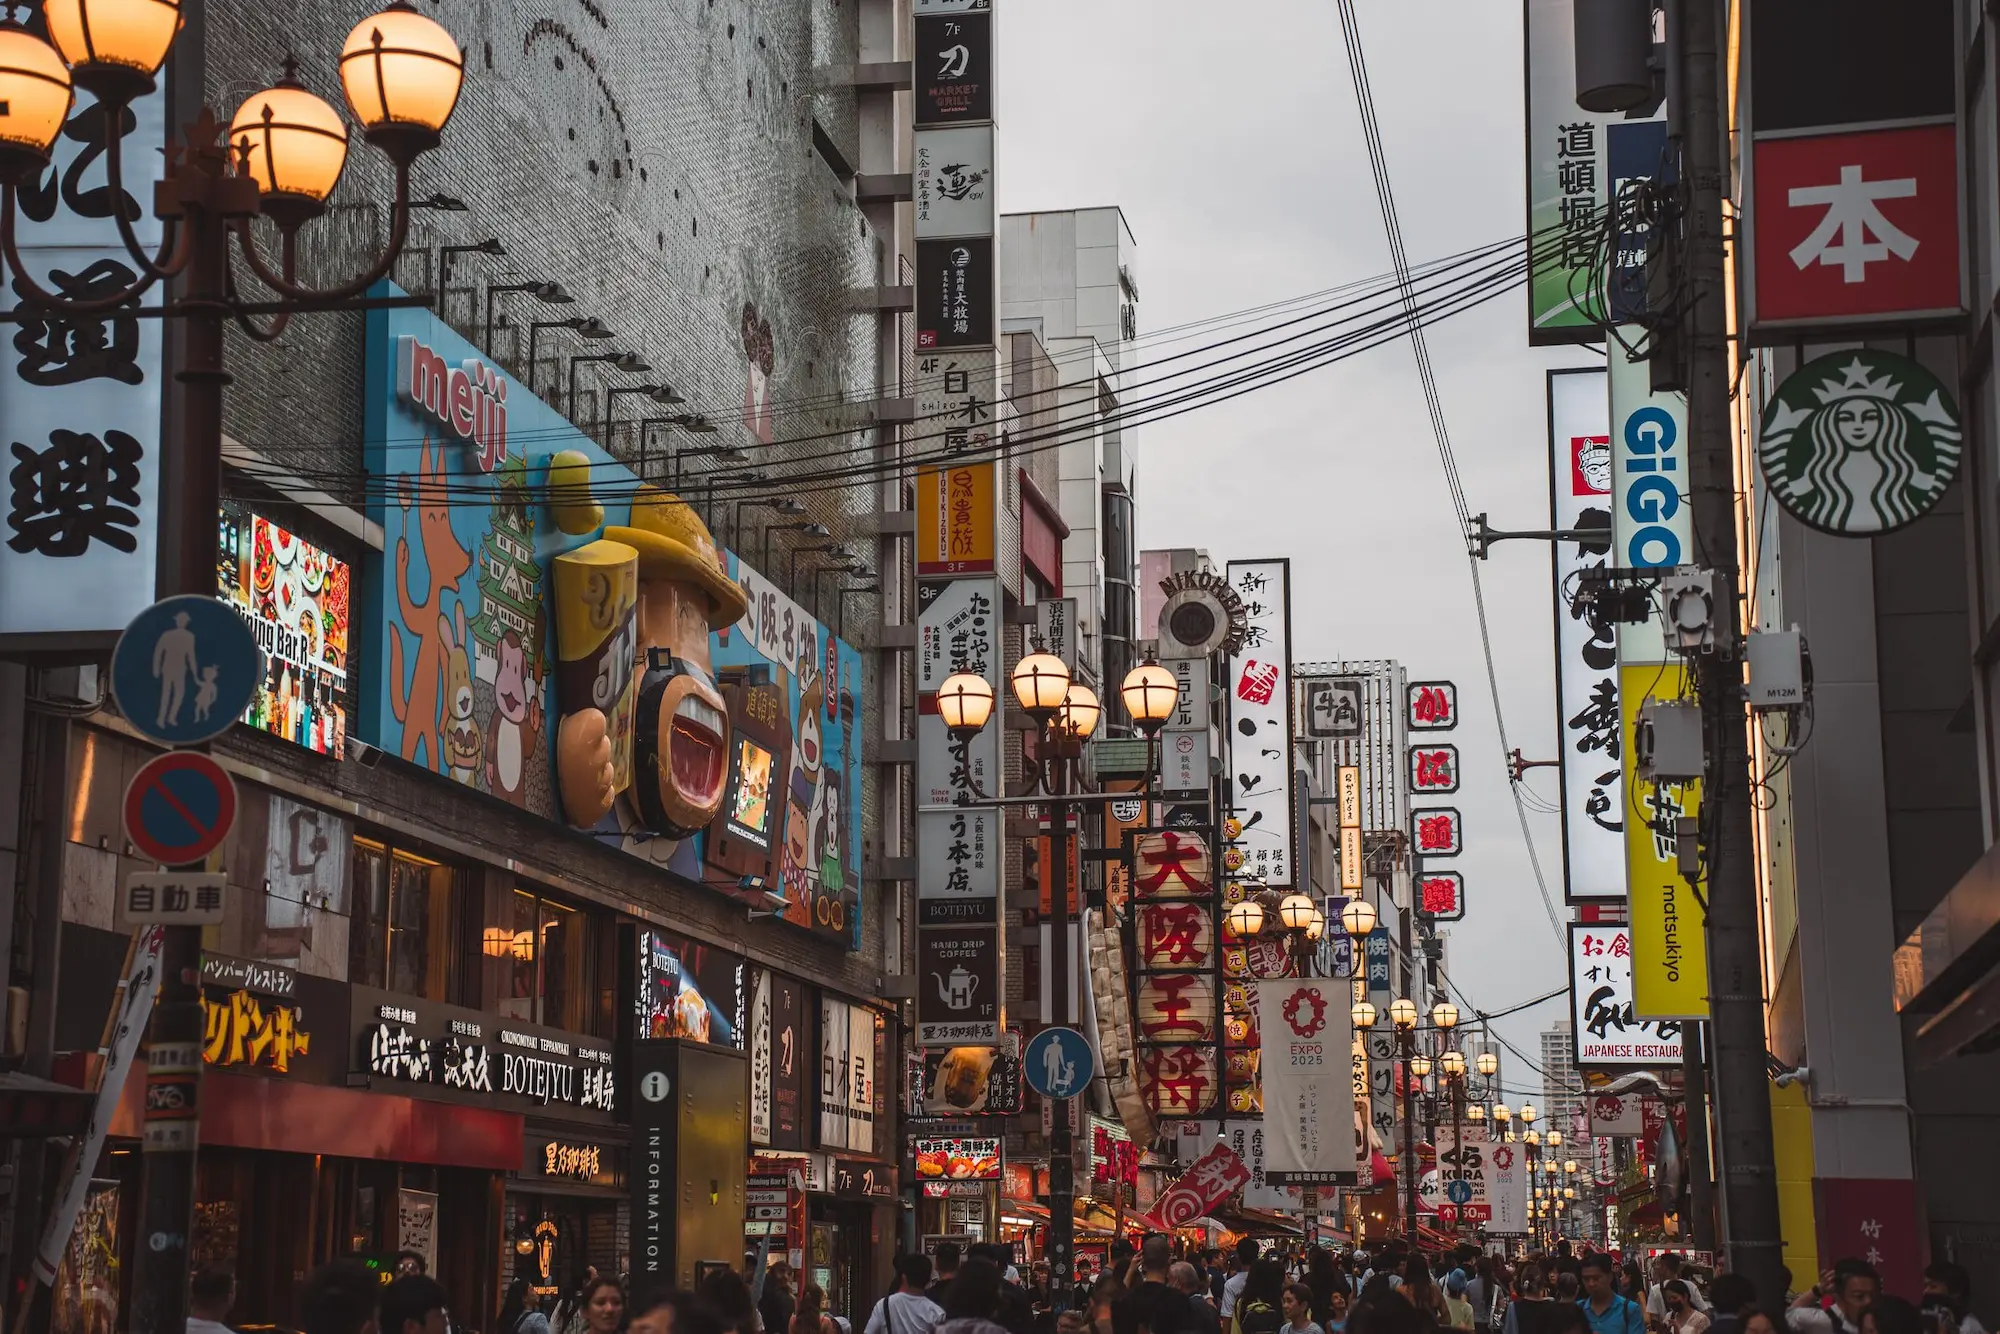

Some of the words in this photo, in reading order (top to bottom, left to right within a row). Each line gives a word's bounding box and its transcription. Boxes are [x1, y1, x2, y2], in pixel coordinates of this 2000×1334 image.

[945, 22, 961, 36] 7F
[929, 84, 979, 96] MARKET
[936, 96, 972, 107] GRILL
[1557, 122, 1597, 270] 道頓堀店
[1788, 164, 1921, 284] 本
[920, 335, 934, 346] 5F
[920, 358, 939, 374] 4F
[410, 336, 508, 475] meiji
[920, 586, 938, 599] 3F
[1767, 688, 1797, 698] M12M
[128, 884, 222, 913] 自動車
[930, 904, 986, 916] BOTEJYU
[1662, 884, 1682, 983] matsukiyo
[931, 941, 958, 950] HAND
[962, 940, 986, 949] DRIP
[939, 950, 978, 958] COFFEE
[1368, 937, 1389, 981] 焼肉
[203, 955, 295, 994] ハンバーグレストラン
[1134, 830, 1215, 1114] 大阪王将
[980, 1003, 993, 1016] 1F
[501, 1029, 538, 1050] OKONOMIYAKI
[540, 1038, 570, 1056] TEPPANYAKI
[1290, 1044, 1323, 1055] EXPO
[1583, 1045, 1632, 1058] JAPANESE
[1291, 1055, 1323, 1066] 2025
[545, 1141, 601, 1181] 星乃珈琲店
[839, 1170, 852, 1190] 7F
[647, 1127, 661, 1272] INFORMATION
